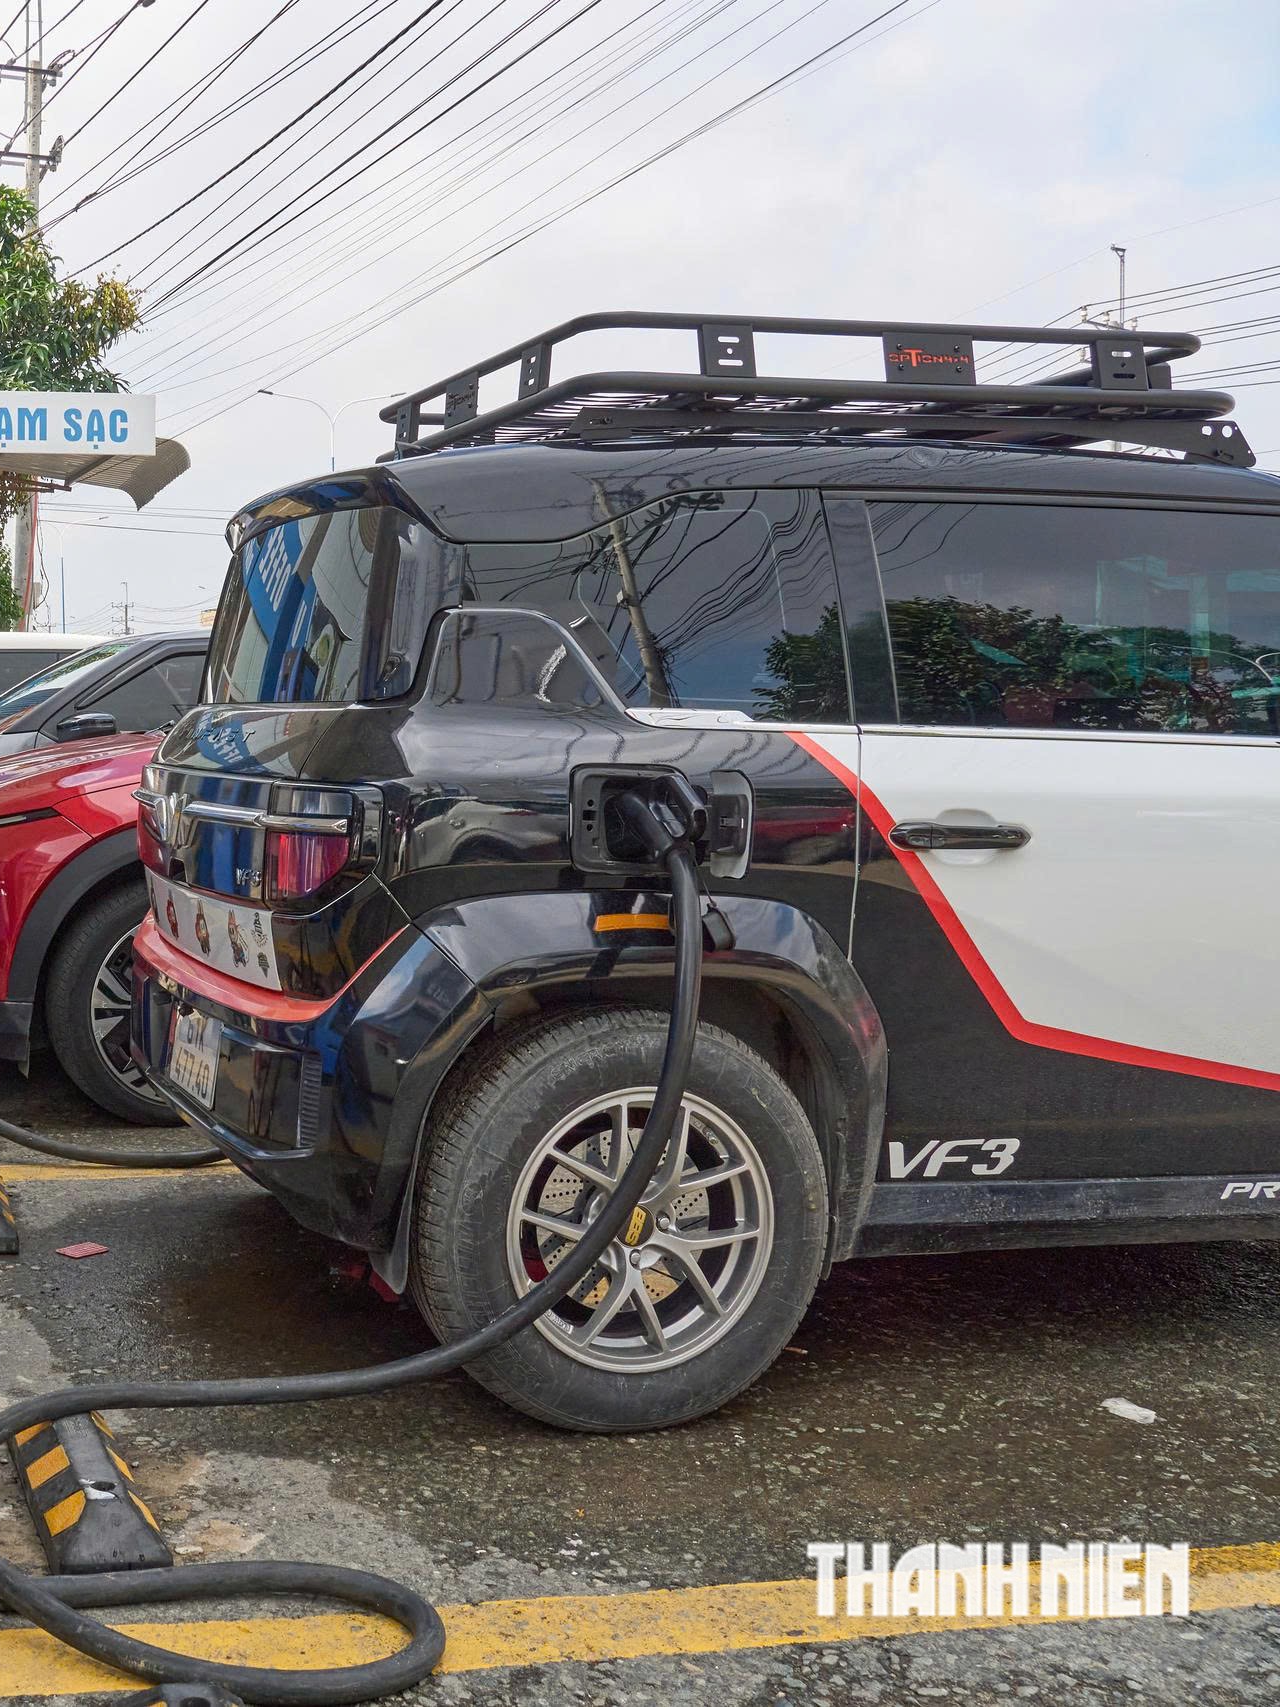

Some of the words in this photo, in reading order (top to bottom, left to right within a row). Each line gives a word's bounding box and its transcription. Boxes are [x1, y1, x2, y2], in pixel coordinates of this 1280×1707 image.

[64, 408, 129, 450] SẠC
[888, 1138, 1020, 1179] VF3
[625, 1206, 647, 1246] BBS
